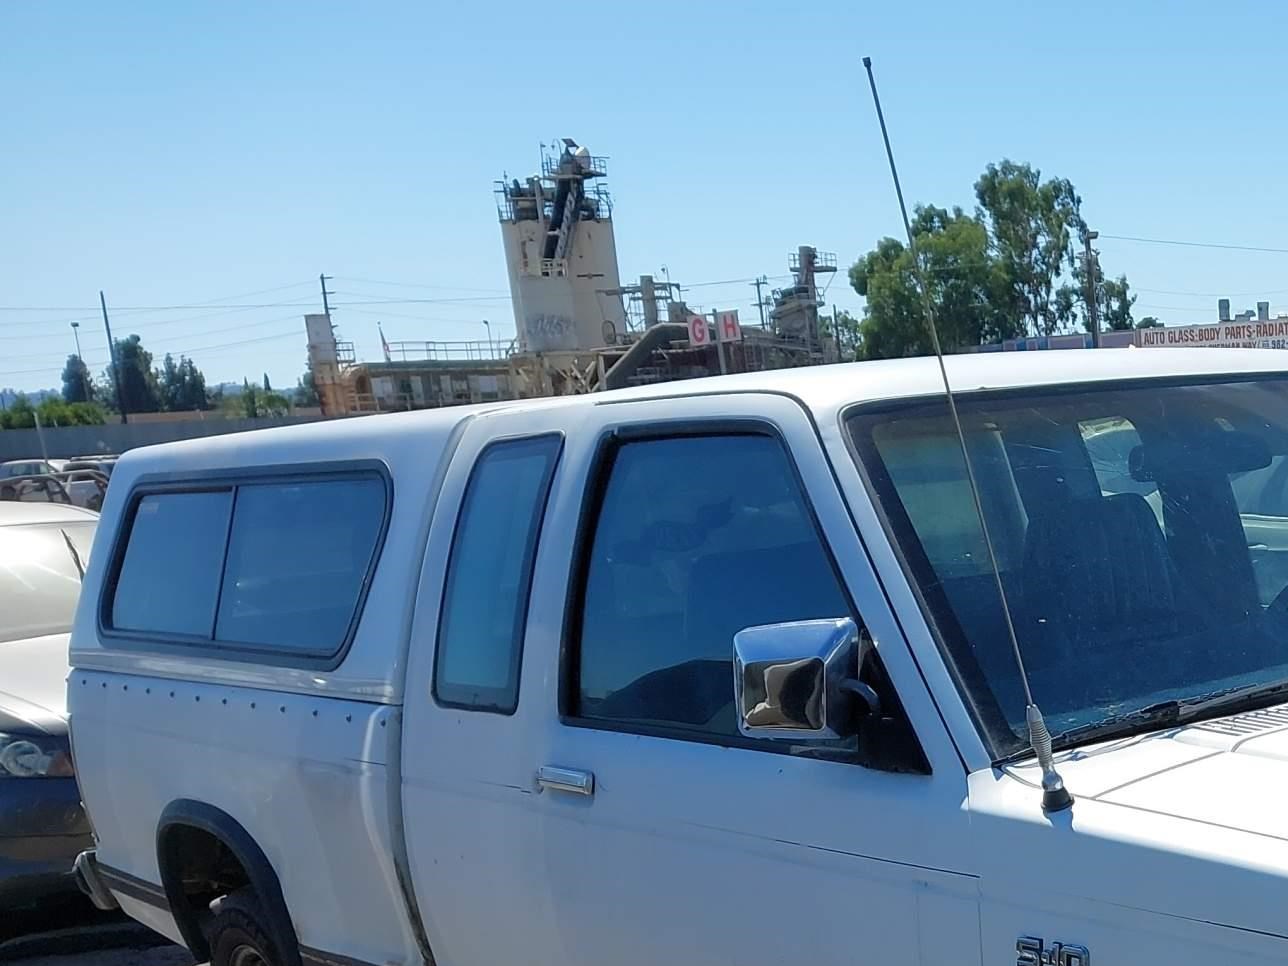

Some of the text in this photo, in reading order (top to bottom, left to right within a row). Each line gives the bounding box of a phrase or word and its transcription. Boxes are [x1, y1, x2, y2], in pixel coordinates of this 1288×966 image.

[692, 317, 705, 342] G
[723, 314, 737, 338] H
[1144, 331, 1165, 345] AUTO
